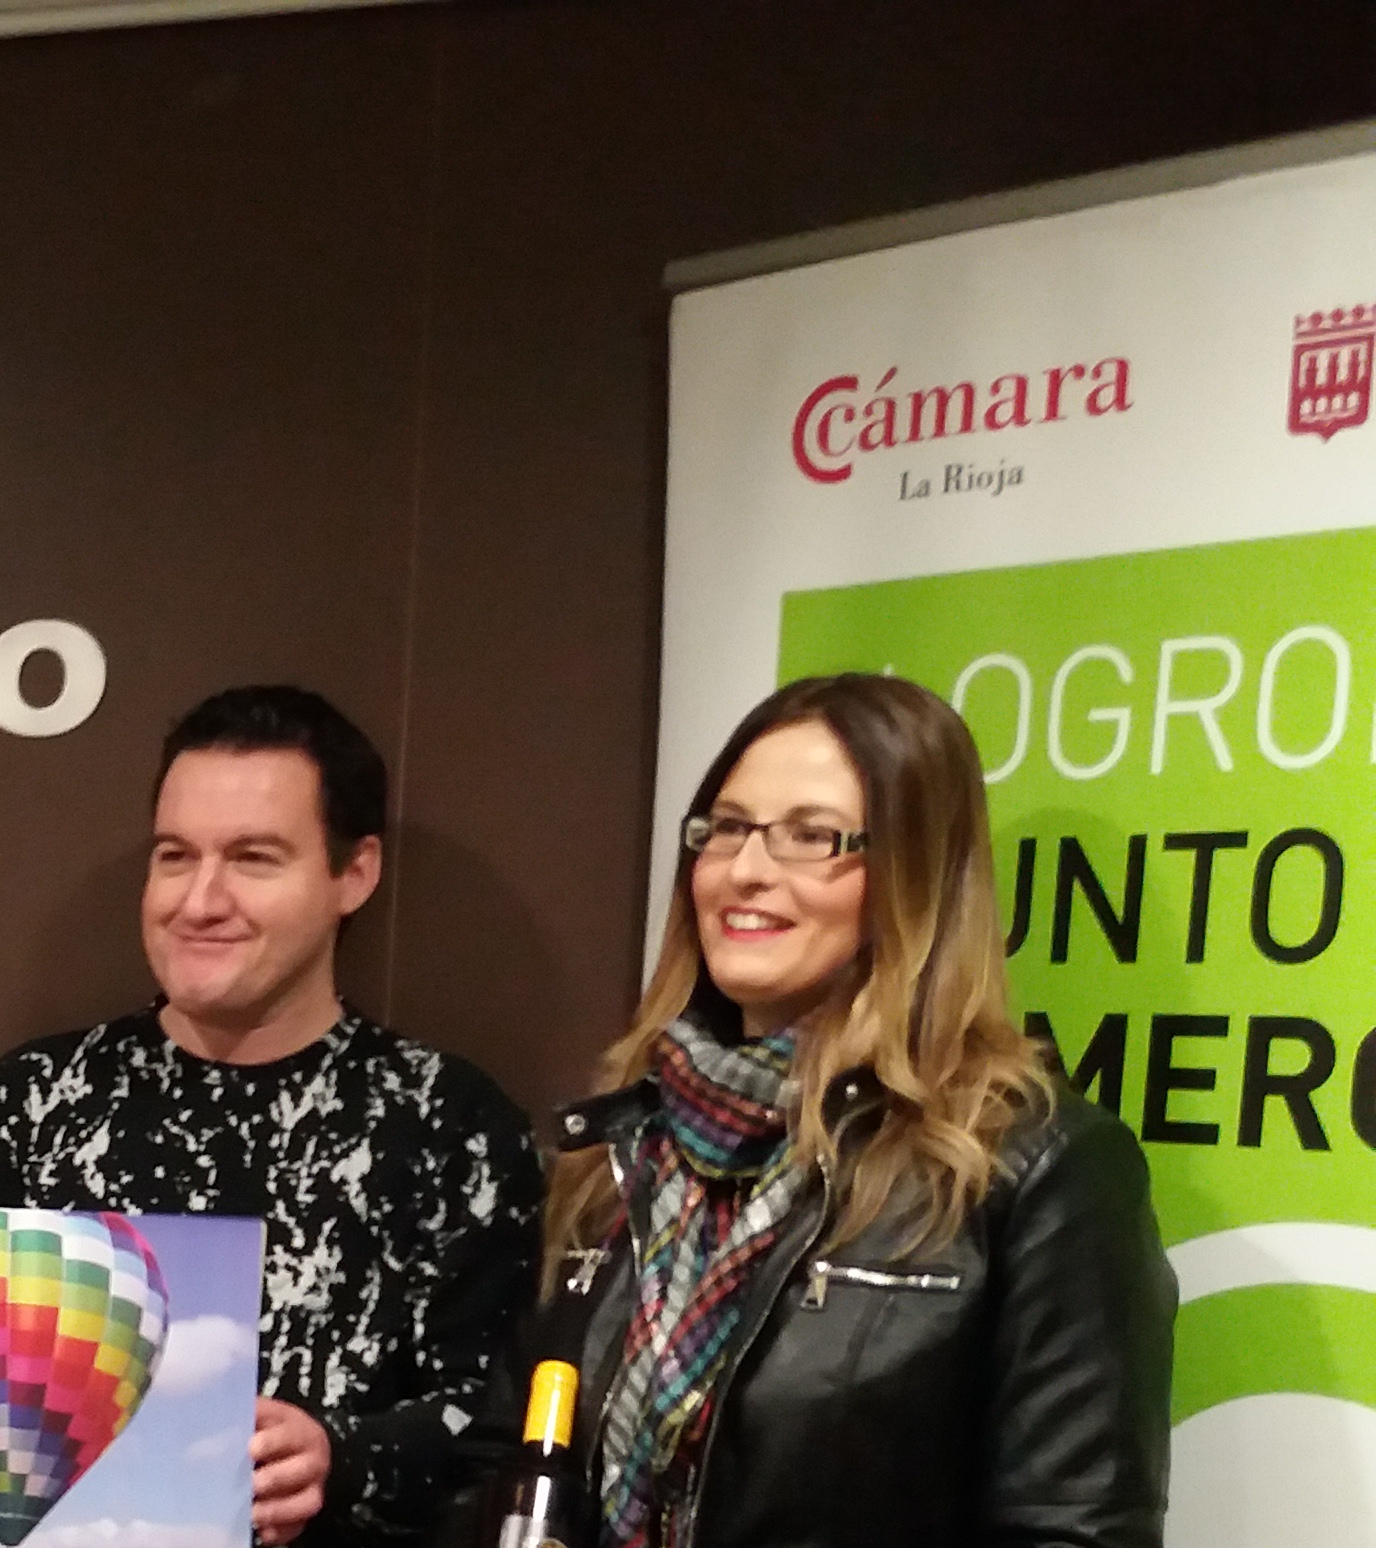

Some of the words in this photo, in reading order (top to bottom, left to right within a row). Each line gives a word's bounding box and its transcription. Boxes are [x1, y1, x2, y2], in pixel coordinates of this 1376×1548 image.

[898, 470, 932, 501] La
[942, 458, 1026, 497] Rioja
[951, 625, 1376, 784] OGRO
